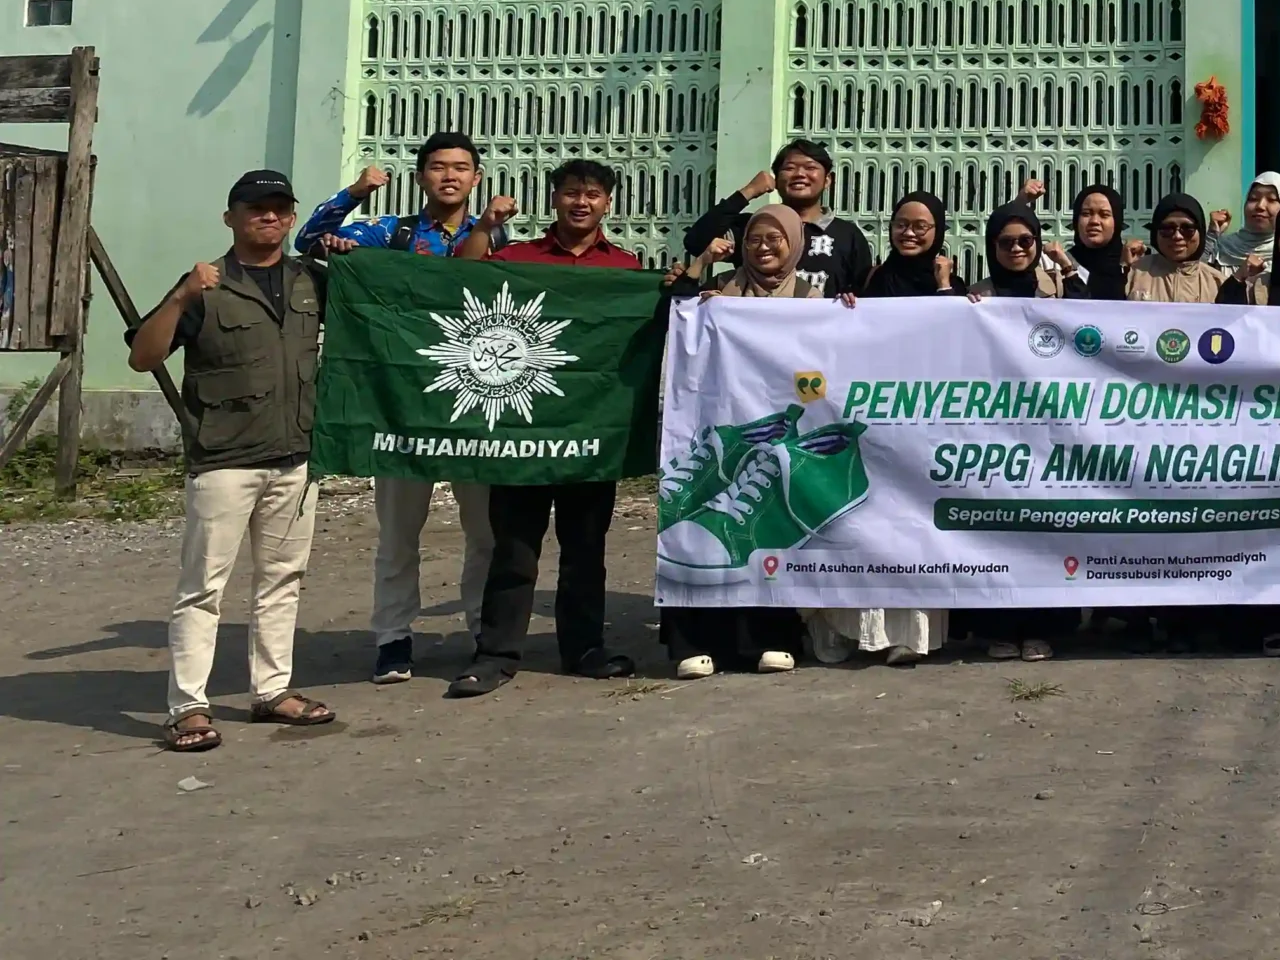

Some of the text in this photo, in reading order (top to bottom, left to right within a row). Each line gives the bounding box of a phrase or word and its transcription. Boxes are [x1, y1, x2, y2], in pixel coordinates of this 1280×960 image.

[843, 381, 1092, 422] PENYERAHAN
[1100, 382, 1238, 422] DONASI
[372, 432, 600, 459] MUHAMMADIYAH
[930, 443, 1032, 484] SPPG
[1041, 443, 1136, 484] AMM
[948, 506, 1014, 526] Sepatu
[1020, 507, 1122, 527] Penggerak
[1127, 506, 1198, 524] Potensi
[786, 561, 1009, 576] Panti Asuhan Ashabul Kahfi Moyudan
[1086, 552, 1267, 567] Panti Asuhan Muhammadiyah
[1086, 567, 1232, 582] Darussubusi Kulonprogo
